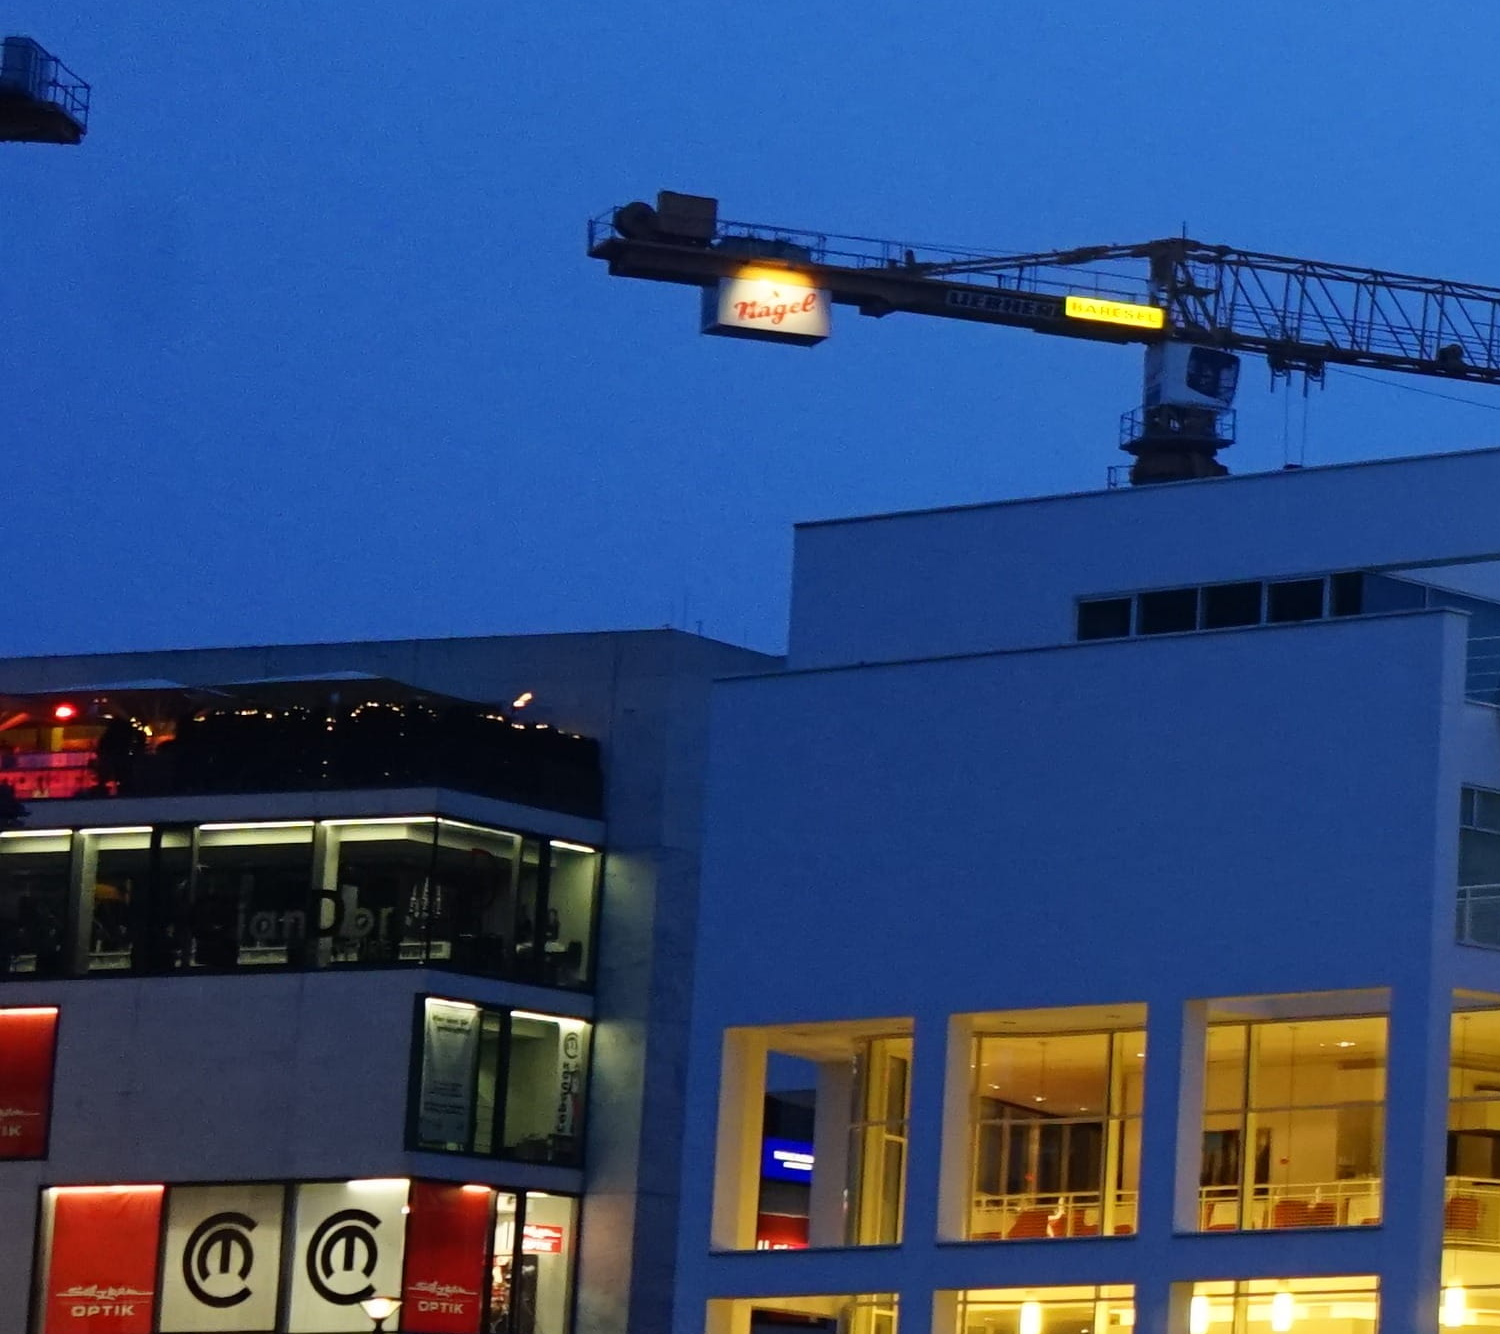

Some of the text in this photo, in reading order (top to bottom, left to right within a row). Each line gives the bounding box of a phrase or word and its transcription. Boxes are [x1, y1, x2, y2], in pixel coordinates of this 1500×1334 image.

[734, 292, 817, 324] Nagel
[70, 1305, 136, 1317] OPTIK
[417, 1301, 464, 1315] OPTIK
